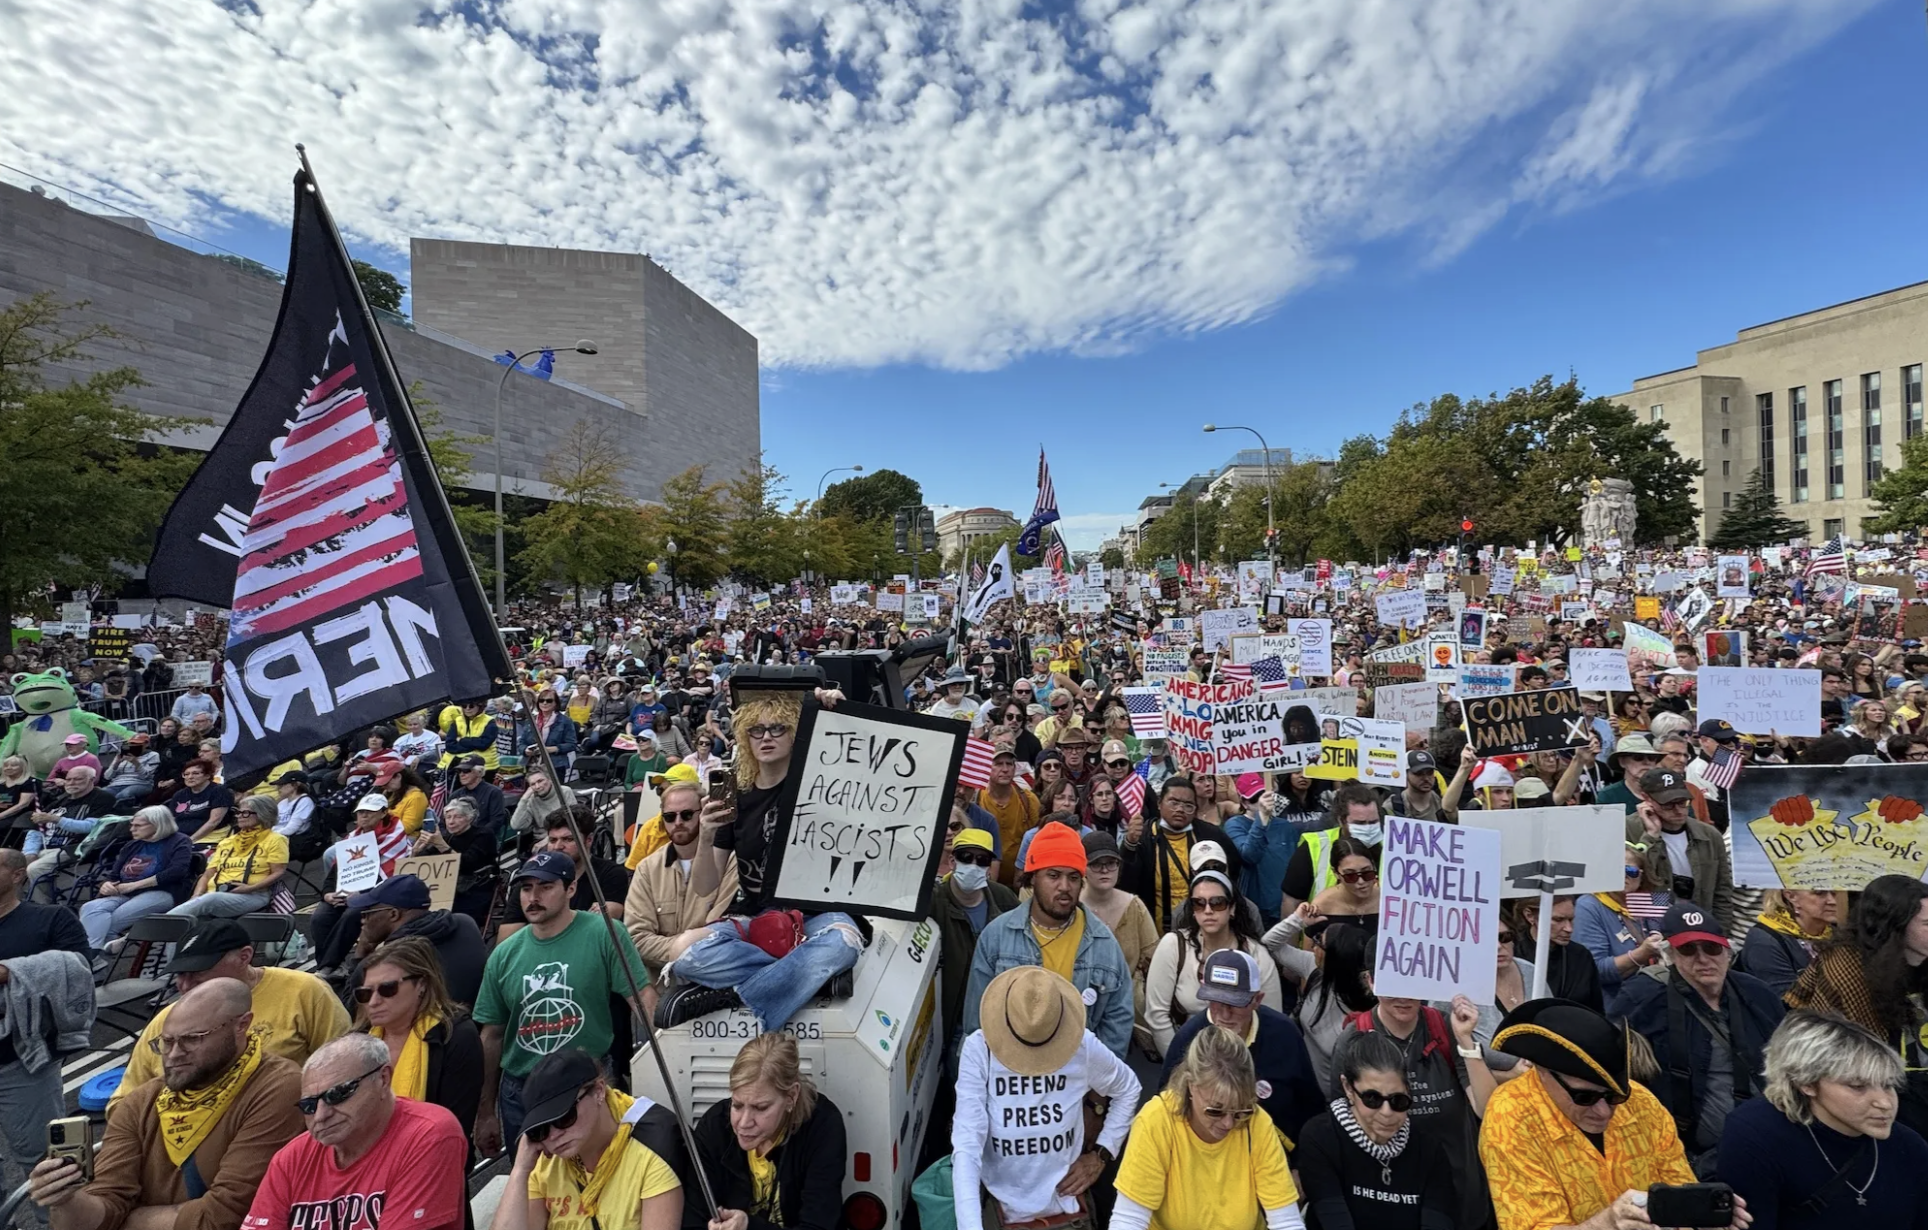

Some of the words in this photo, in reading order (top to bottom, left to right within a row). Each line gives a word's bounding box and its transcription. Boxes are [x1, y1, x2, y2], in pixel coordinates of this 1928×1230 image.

[97, 628, 124, 636] FIRE
[90, 639, 128, 647] TRUMP
[1263, 638, 1295, 648] HANDS
[1376, 650, 1402, 663] FREE
[1631, 647, 1671, 665] PARTY
[1367, 665, 1388, 676] WHEN
[1709, 675, 1731, 686] THE
[1745, 674, 1772, 686] ONLY
[1782, 675, 1819, 685] THING
[1165, 677, 1254, 704] AMERICANS
[1733, 690, 1785, 700] ILLEGAL
[1213, 703, 1282, 726] AMERICA
[1414, 710, 1433, 720] LAW
[1469, 694, 1541, 724] COME
[1544, 690, 1577, 714] ON
[1722, 710, 1805, 722] INJUSTICE
[1222, 729, 1246, 744] you
[1252, 724, 1266, 734] in
[1477, 721, 1527, 750] MAN
[820, 732, 918, 777] JEWS
[1217, 738, 1283, 764] DANGER
[1263, 751, 1302, 769] GIRL!
[809, 774, 938, 815] AGAINST
[1389, 820, 1465, 863] MAKE
[1765, 832, 1805, 859] We
[1854, 822, 1923, 861] People
[352, 865, 376, 876] TRUMP
[1388, 857, 1489, 904] ORWELL
[1383, 896, 1480, 944] FICTION
[1380, 937, 1460, 984] AGAIN
[996, 1075, 1066, 1096] DEFEND
[1003, 1103, 1063, 1127] PRESS
[1353, 1185, 1361, 1195] IS
[1363, 1187, 1375, 1199] HE
[1377, 1191, 1400, 1203] DEAD
